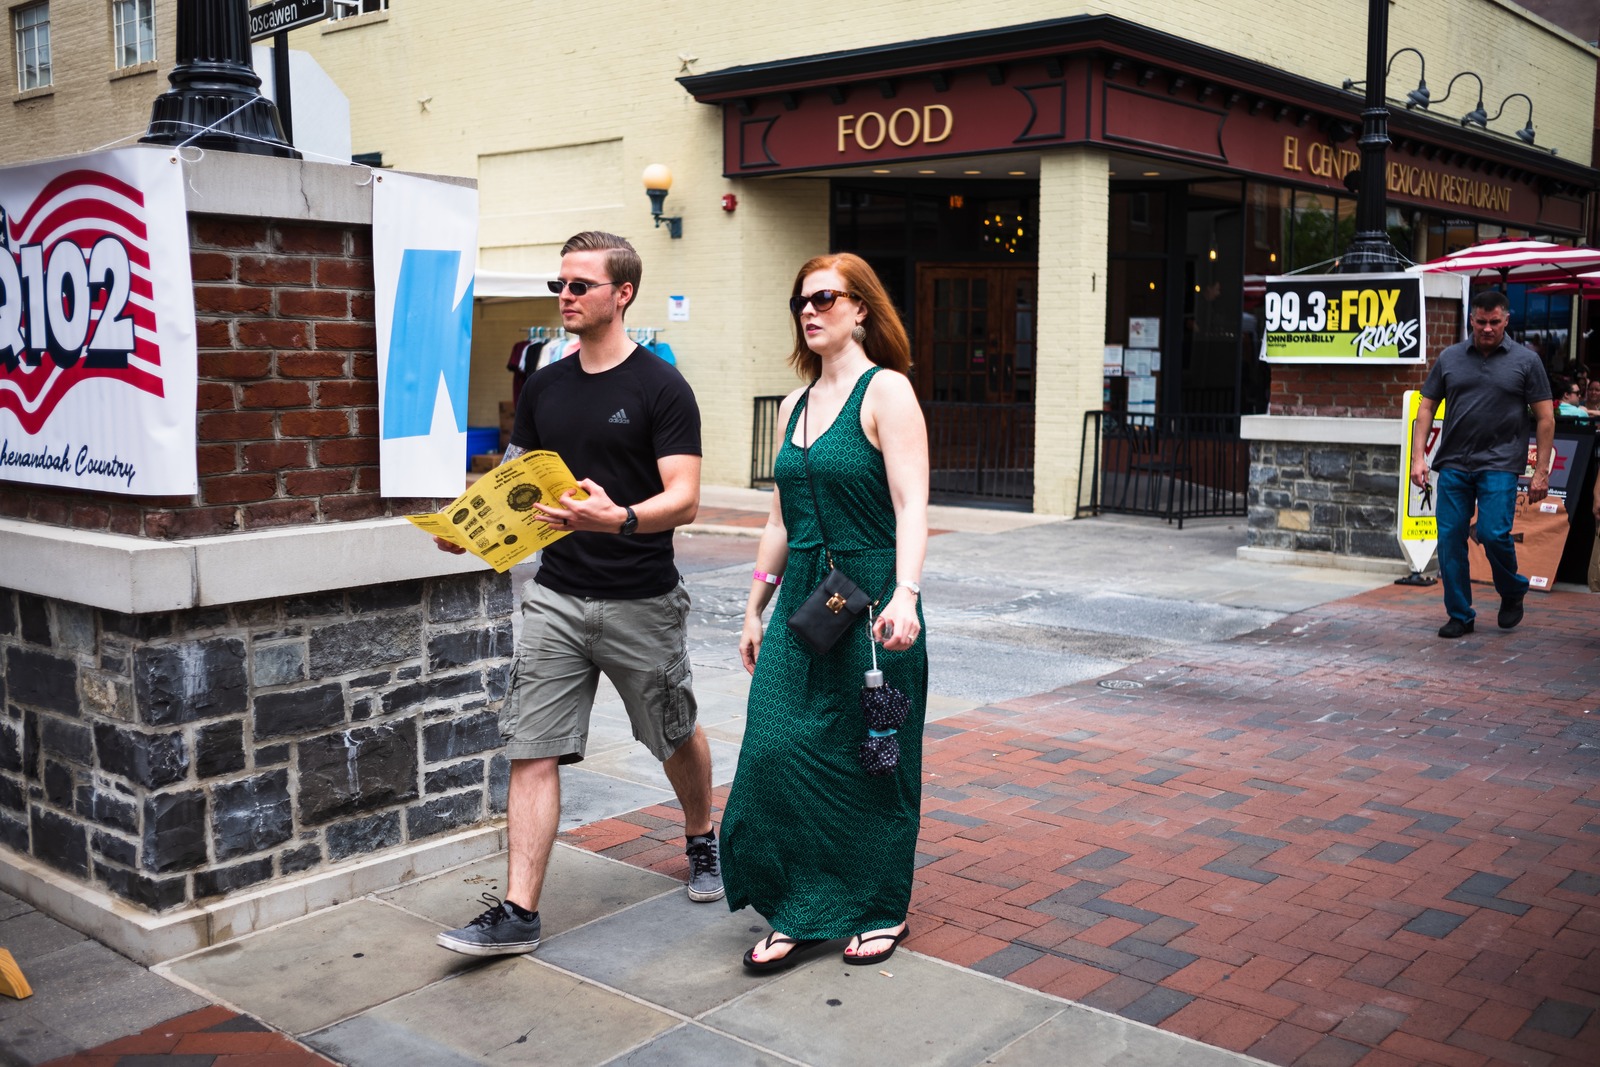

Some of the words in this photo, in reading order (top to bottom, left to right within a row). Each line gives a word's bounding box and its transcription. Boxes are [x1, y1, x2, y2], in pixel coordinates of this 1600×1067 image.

[838, 104, 953, 152] FOOD
[1283, 135, 1303, 172] EL
[1307, 142, 1360, 181] CENTR
[1440, 174, 1512, 213] RESTAURANT
[1265, 290, 1326, 332] 99.3
[1326, 299, 1340, 331] THE
[1341, 288, 1401, 331] FOX
[1351, 318, 1419, 357] ROCKS
[0, 438, 71, 474] henandoah
[75, 444, 136, 488] Country
